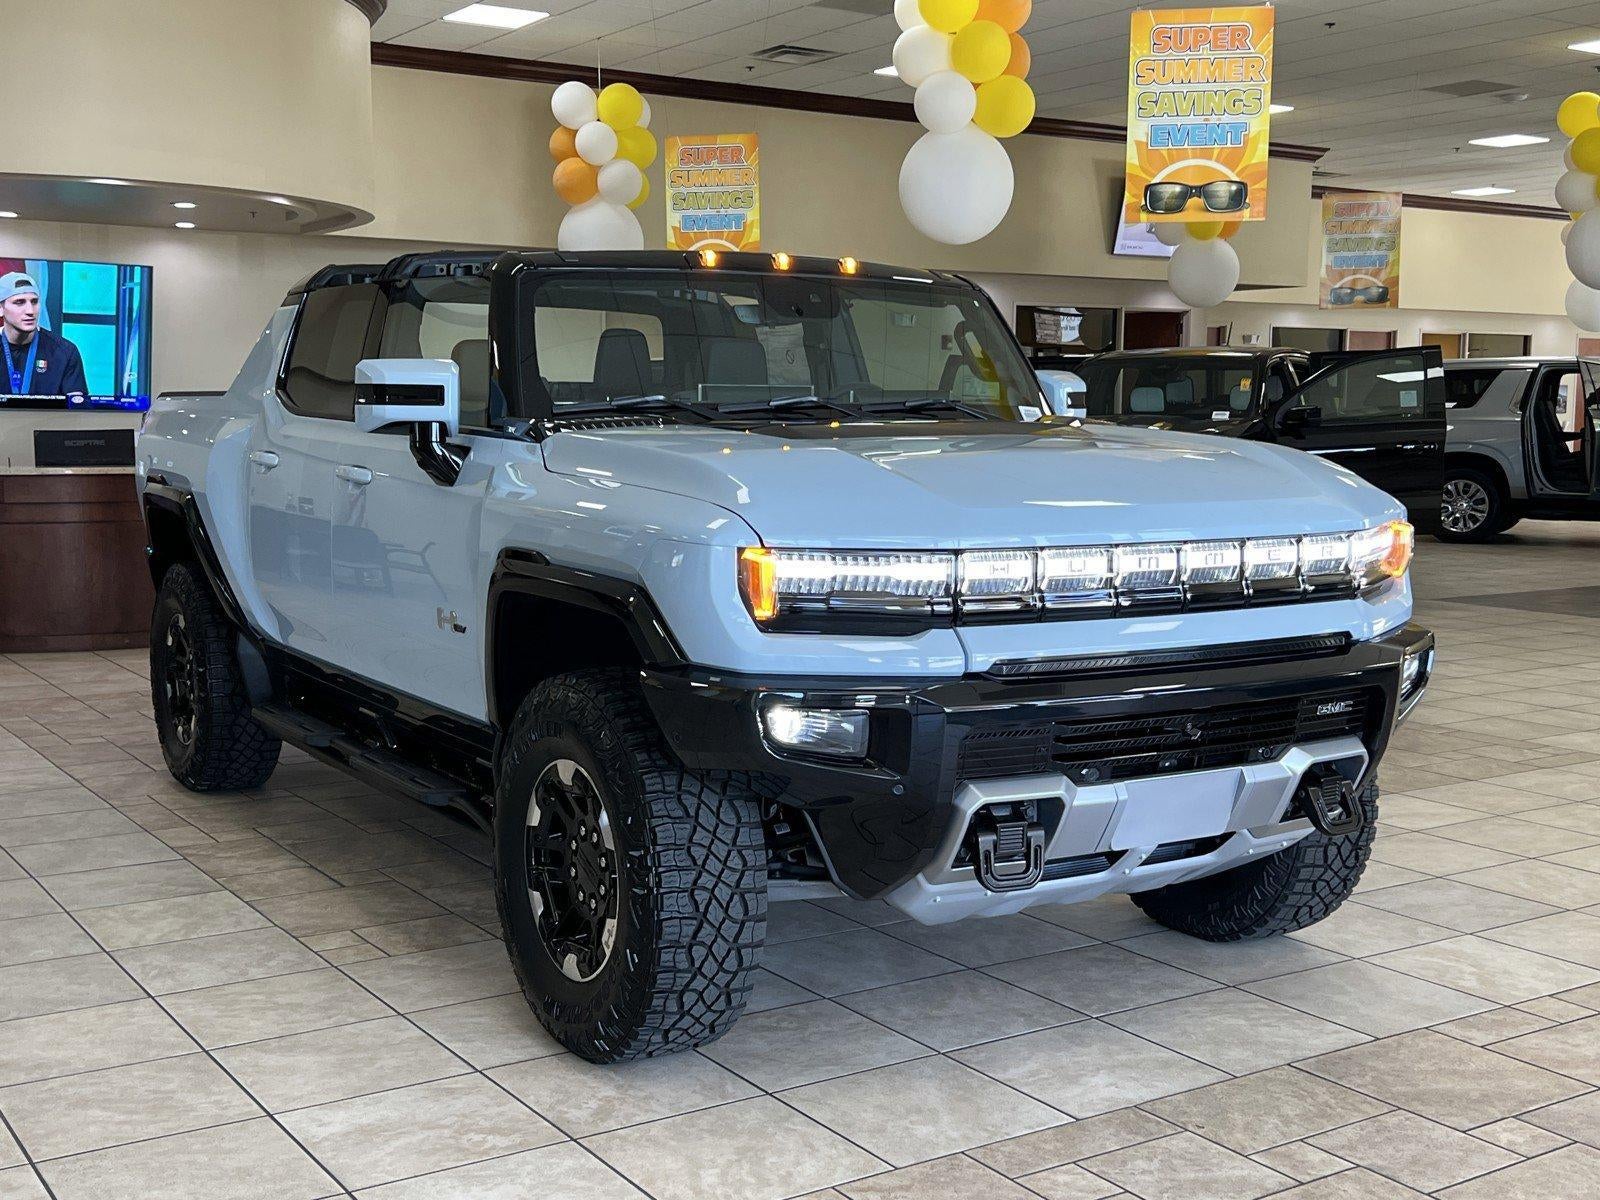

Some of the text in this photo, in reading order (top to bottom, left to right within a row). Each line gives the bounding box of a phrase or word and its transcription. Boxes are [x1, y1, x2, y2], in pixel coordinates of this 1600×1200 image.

[1152, 25, 1251, 53] SUPER
[1136, 57, 1266, 85] SUMMER
[1138, 89, 1263, 118] SAVINGS
[1149, 122, 1248, 147] EVENT
[679, 146, 745, 167] SUPER
[670, 168, 755, 188] SUMMER
[672, 190, 754, 211] SAVINGS
[1334, 202, 1391, 218] SUPER
[681, 213, 746, 231] EVENT
[1324, 219, 1398, 235] SUMMER
[1326, 237, 1396, 253] SAVINGS
[1333, 254, 1388, 268] EVENT
[1317, 701, 1353, 715] GMC
